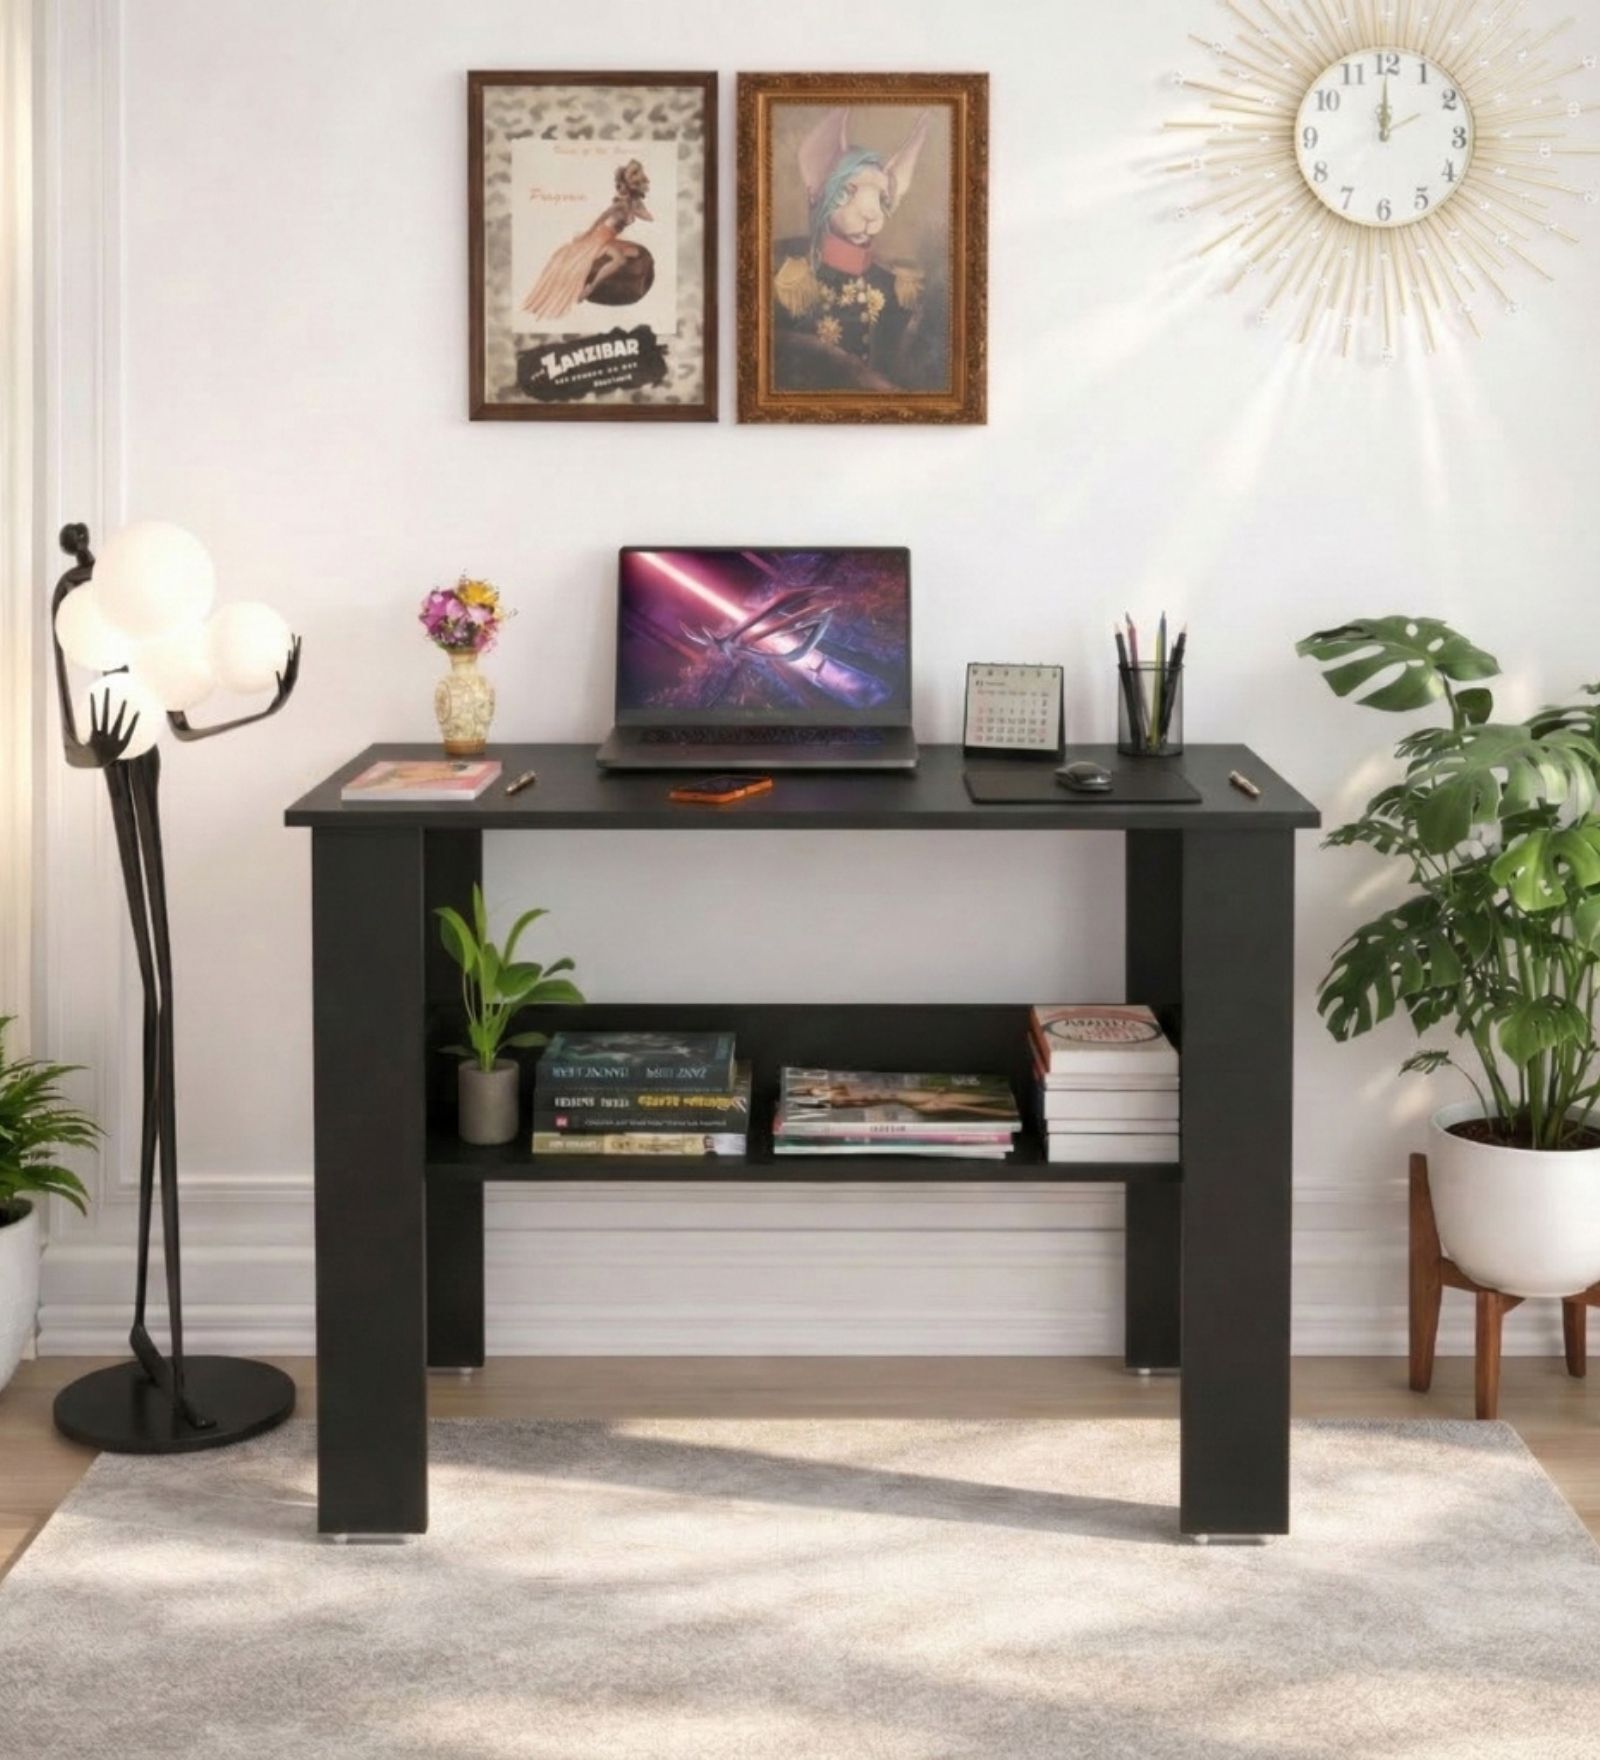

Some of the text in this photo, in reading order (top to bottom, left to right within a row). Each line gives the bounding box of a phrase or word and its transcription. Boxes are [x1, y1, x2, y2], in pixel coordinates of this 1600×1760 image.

[1340, 63, 1365, 86] 11
[1374, 53, 1400, 76] 12
[1417, 63, 1428, 84] 1
[1315, 89, 1341, 112] 10
[1442, 88, 1457, 111] 2
[1303, 127, 1318, 149] 9
[1452, 126, 1467, 149] 3
[1313, 161, 1328, 183] 8
[1441, 158, 1458, 183] 4
[1340, 186, 1355, 210] 7
[1414, 186, 1428, 210] 5
[1376, 199, 1391, 221] 6
[541, 338, 639, 380] ZANZIBAR
